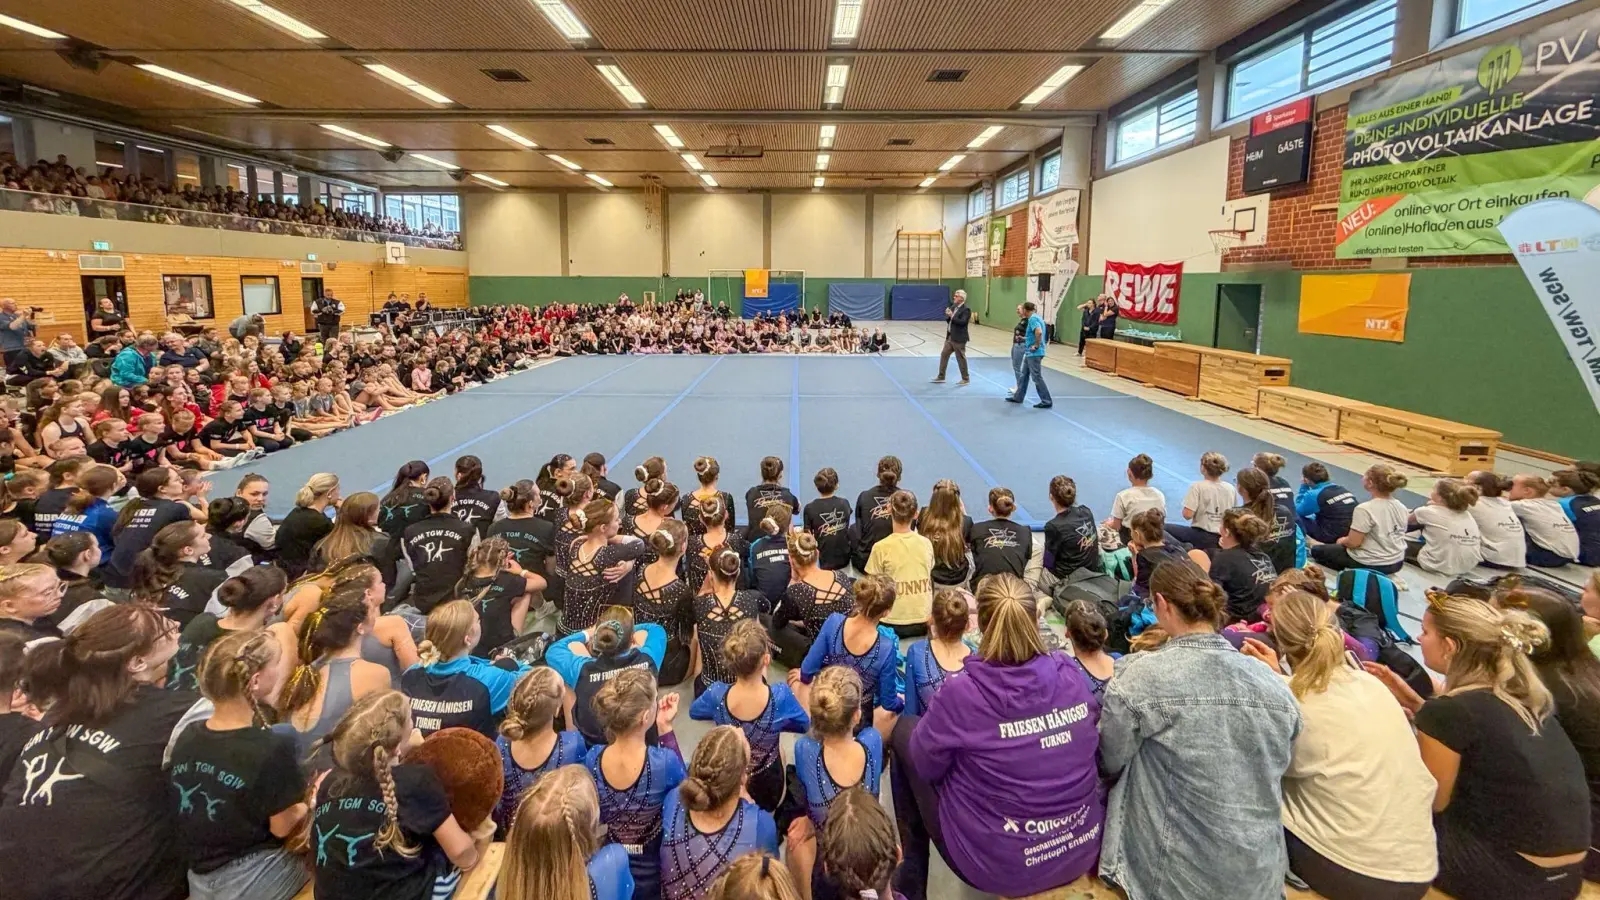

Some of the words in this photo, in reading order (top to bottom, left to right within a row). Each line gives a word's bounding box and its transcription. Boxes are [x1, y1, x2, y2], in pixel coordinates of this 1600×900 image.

[1535, 29, 1588, 72] PV
[1356, 113, 1376, 125] ALLES
[1378, 108, 1395, 118] AUS
[1396, 101, 1420, 114] EINER
[1422, 91, 1452, 106] HAND!
[1354, 124, 1396, 146] DEINE
[1400, 92, 1524, 135] INDIVIDUELLE
[1352, 99, 1594, 166] PHOTOVOLTAIKANLAGE
[1246, 150, 1264, 162] HEIM
[1350, 177, 1361, 187] IHR
[1361, 163, 1446, 185] ANSPRECHPARTNER
[1349, 188, 1370, 198] RUND
[1371, 186, 1384, 195] UM
[1385, 174, 1458, 193] PHOTOVOLTAIK
[1394, 204, 1431, 218] online
[1433, 202, 1456, 214] vor
[1458, 197, 1482, 211] Ort
[1341, 203, 1377, 235] NEU:
[1467, 218, 1494, 230] aus
[1383, 246, 1397, 254] mal
[1398, 245, 1424, 253] testen
[1105, 269, 1177, 314] REWE
[1365, 318, 1389, 330] NTJ
[426, 530, 443, 538] TGW
[444, 530, 462, 541] SGW
[168, 585, 190, 599] SGW
[589, 673, 601, 683] TSV
[410, 698, 437, 712] FRIESEN
[436, 700, 473, 713] HÄNIGSEN
[415, 716, 442, 730] TURNEN
[999, 715, 1047, 738] FRIESEN
[1045, 702, 1089, 729] HÄNIGSEN
[79, 728, 121, 753] SGW
[1040, 730, 1072, 749] TURNEN
[172, 763, 188, 776] GW
[217, 770, 245, 789] SGW
[315, 801, 331, 818] GW
[338, 797, 363, 810] TGM
[367, 799, 388, 816] SG
